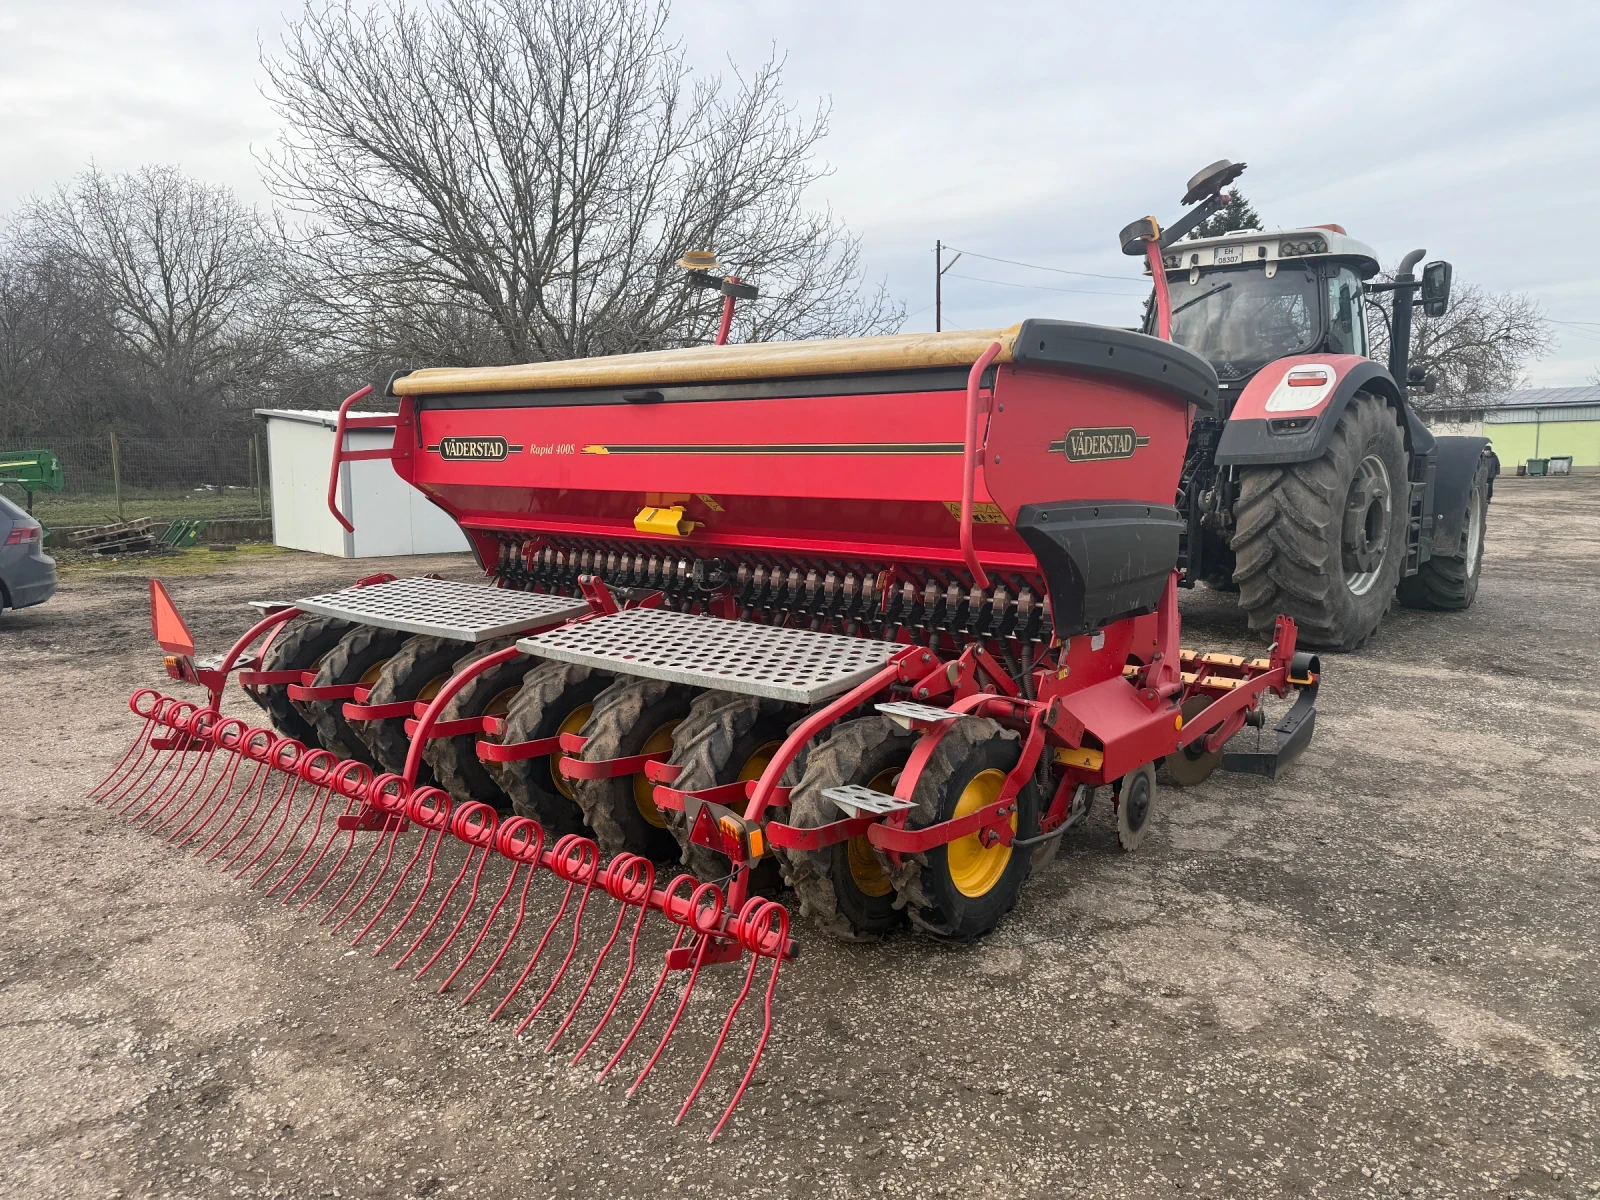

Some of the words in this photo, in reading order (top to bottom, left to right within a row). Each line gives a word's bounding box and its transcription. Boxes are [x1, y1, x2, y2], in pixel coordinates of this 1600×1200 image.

[444, 439, 504, 457] VÄDERSTAD
[530, 444, 553, 457] Rapid
[555, 444, 575, 455] 400S
[1070, 432, 1132, 456] VÄDERSTAD
